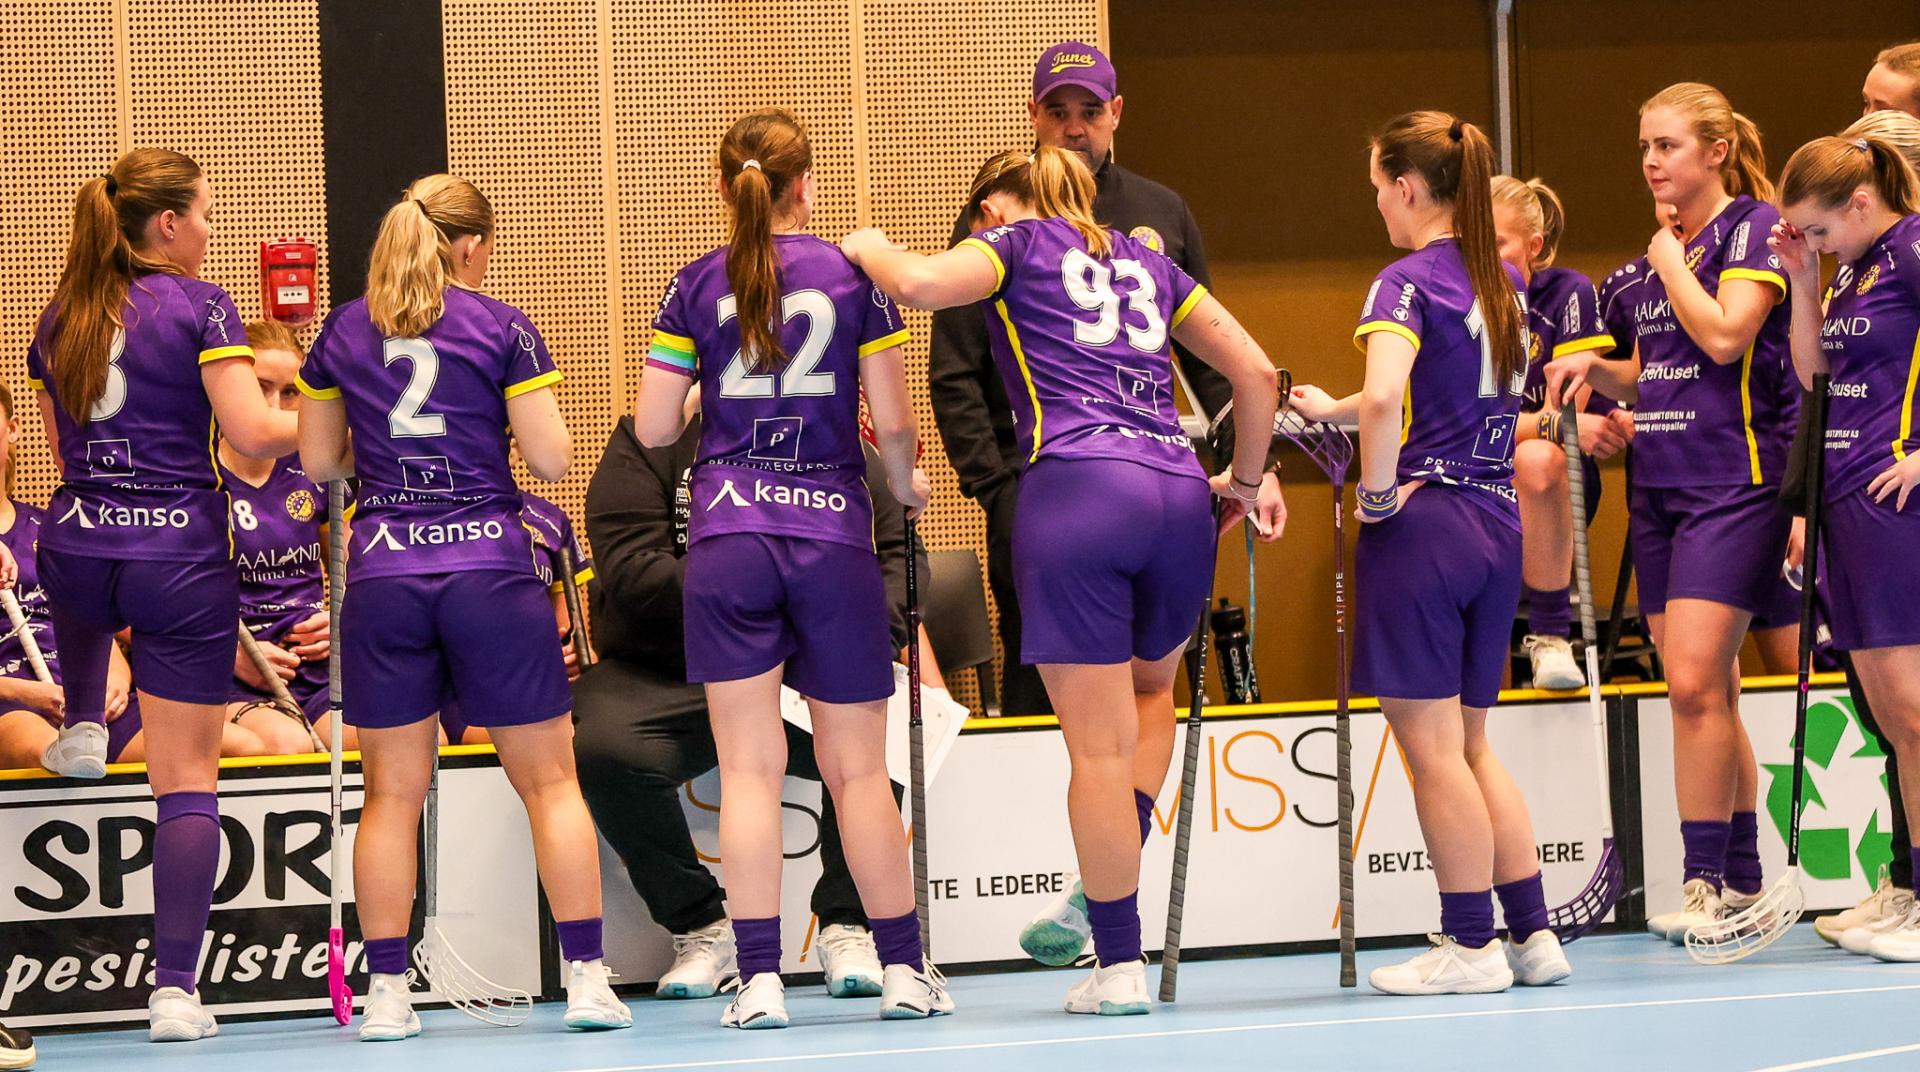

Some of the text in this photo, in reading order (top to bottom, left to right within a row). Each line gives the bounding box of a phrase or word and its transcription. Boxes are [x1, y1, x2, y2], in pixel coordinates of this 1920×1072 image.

[1061, 246, 1167, 354] 93
[717, 288, 837, 399] 22
[383, 335, 447, 439] 2
[1685, 410, 1696, 420] AS
[754, 479, 846, 513] kanso
[98, 503, 189, 529] kanso
[229, 499, 259, 531] 8
[409, 521, 503, 546] kanso
[242, 570, 285, 583] klima
[1229, 647, 1245, 688] CRAFT
[14, 809, 363, 913] SPR
[976, 872, 1063, 898] LEDERE
